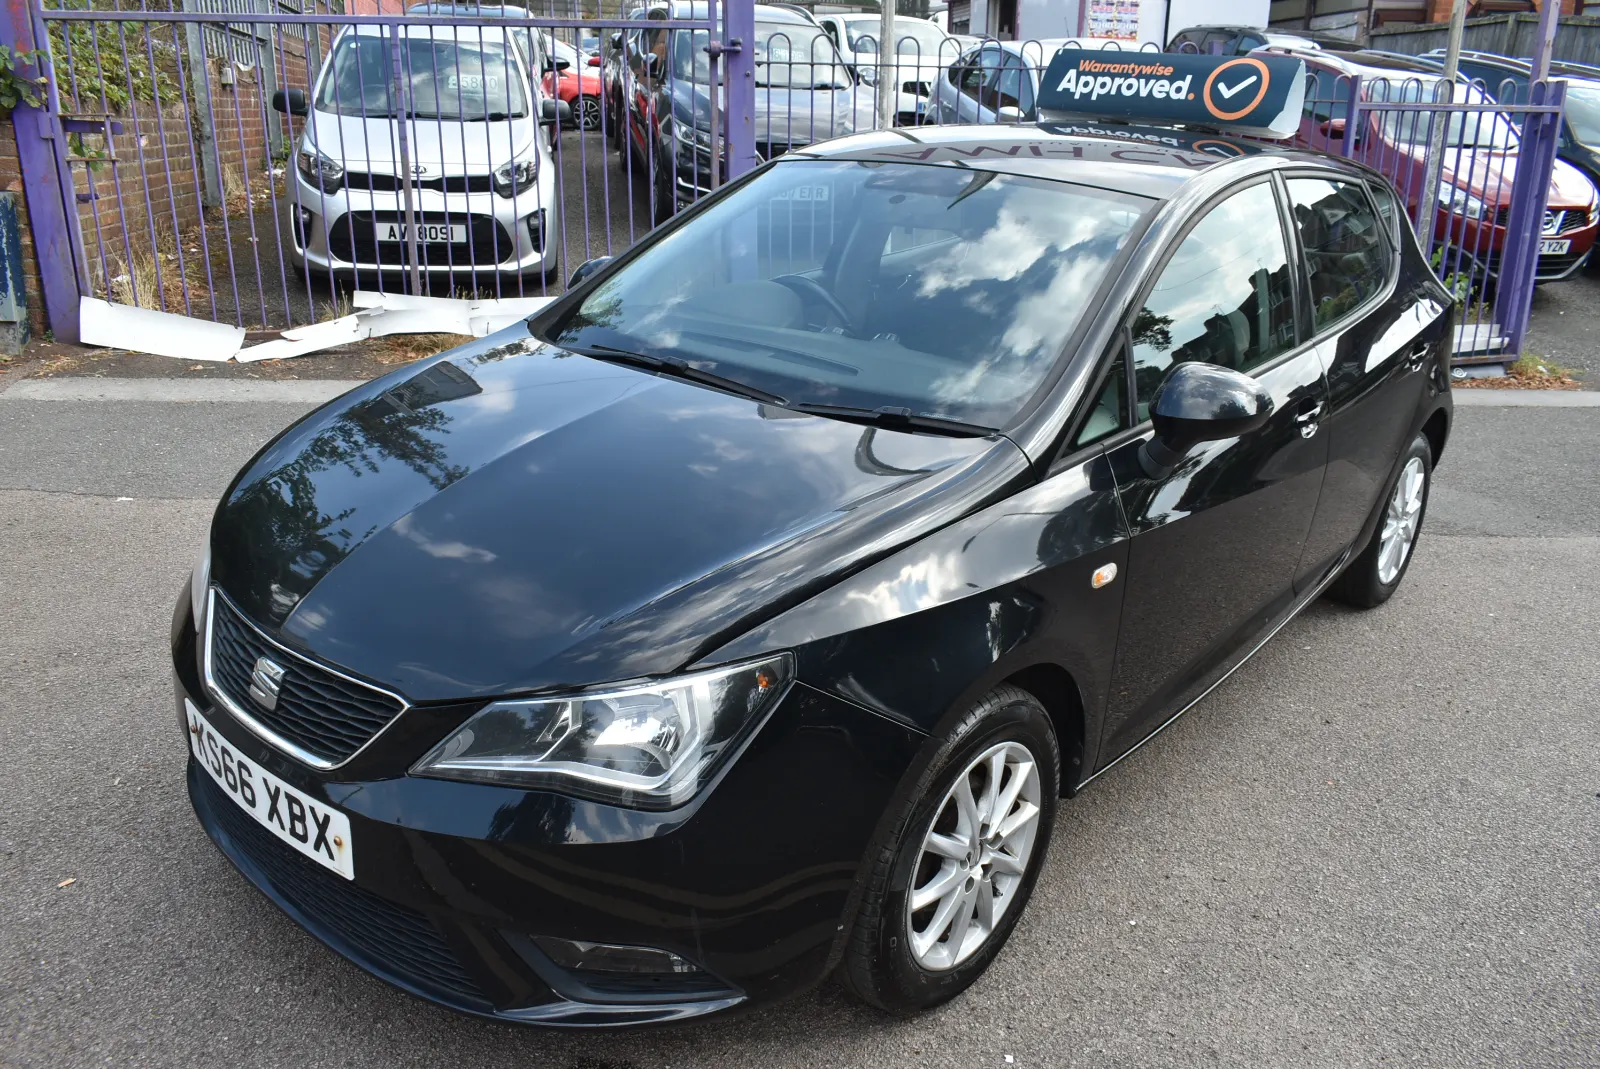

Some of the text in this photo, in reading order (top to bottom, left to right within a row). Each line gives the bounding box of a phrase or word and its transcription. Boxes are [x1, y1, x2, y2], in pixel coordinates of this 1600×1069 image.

[1079, 60, 1174, 77] Warrantywise
[1056, 69, 1195, 101] Approved.
[1547, 242, 1567, 252] YZK
[194, 714, 336, 862] KS66 XBX
